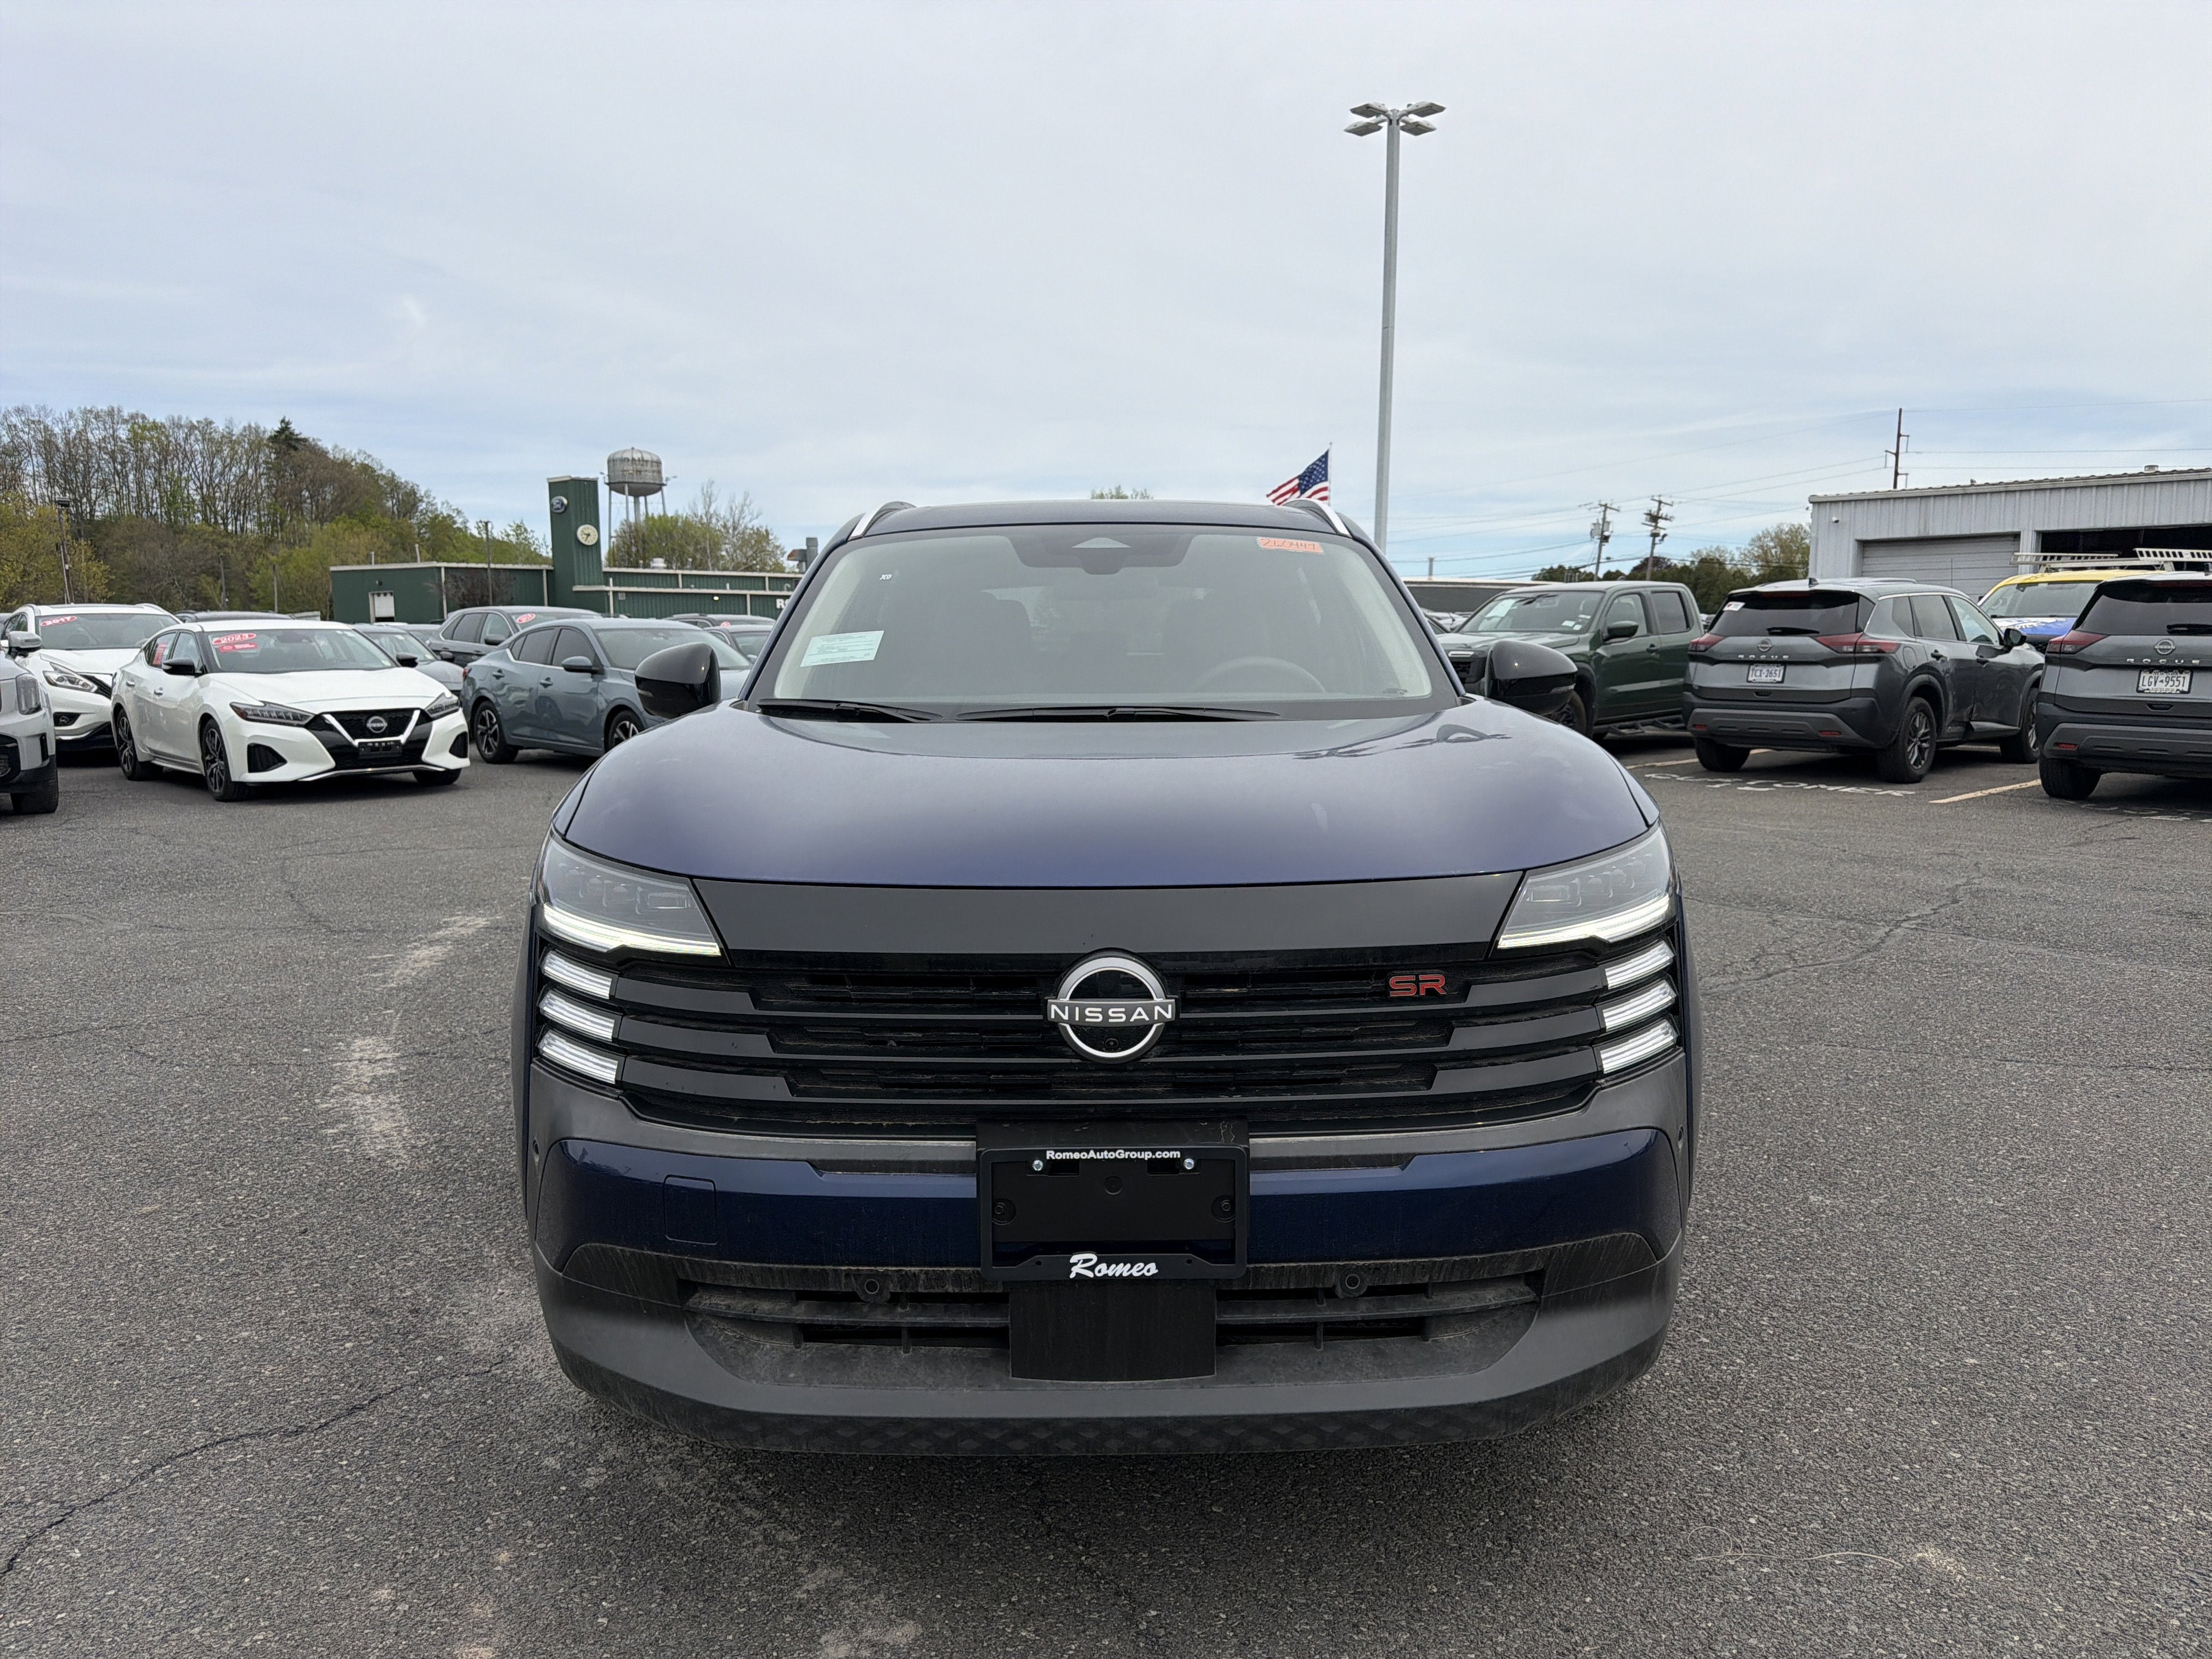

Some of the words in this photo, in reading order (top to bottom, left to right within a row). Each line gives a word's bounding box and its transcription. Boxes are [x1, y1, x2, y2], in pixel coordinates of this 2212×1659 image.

[1389, 974, 1447, 996] SR
[1051, 1004, 1172, 1022] NISSAN
[1046, 1149, 1181, 1160] RomeoAutoGroup.com
[1069, 1253, 1159, 1279] Romeo
